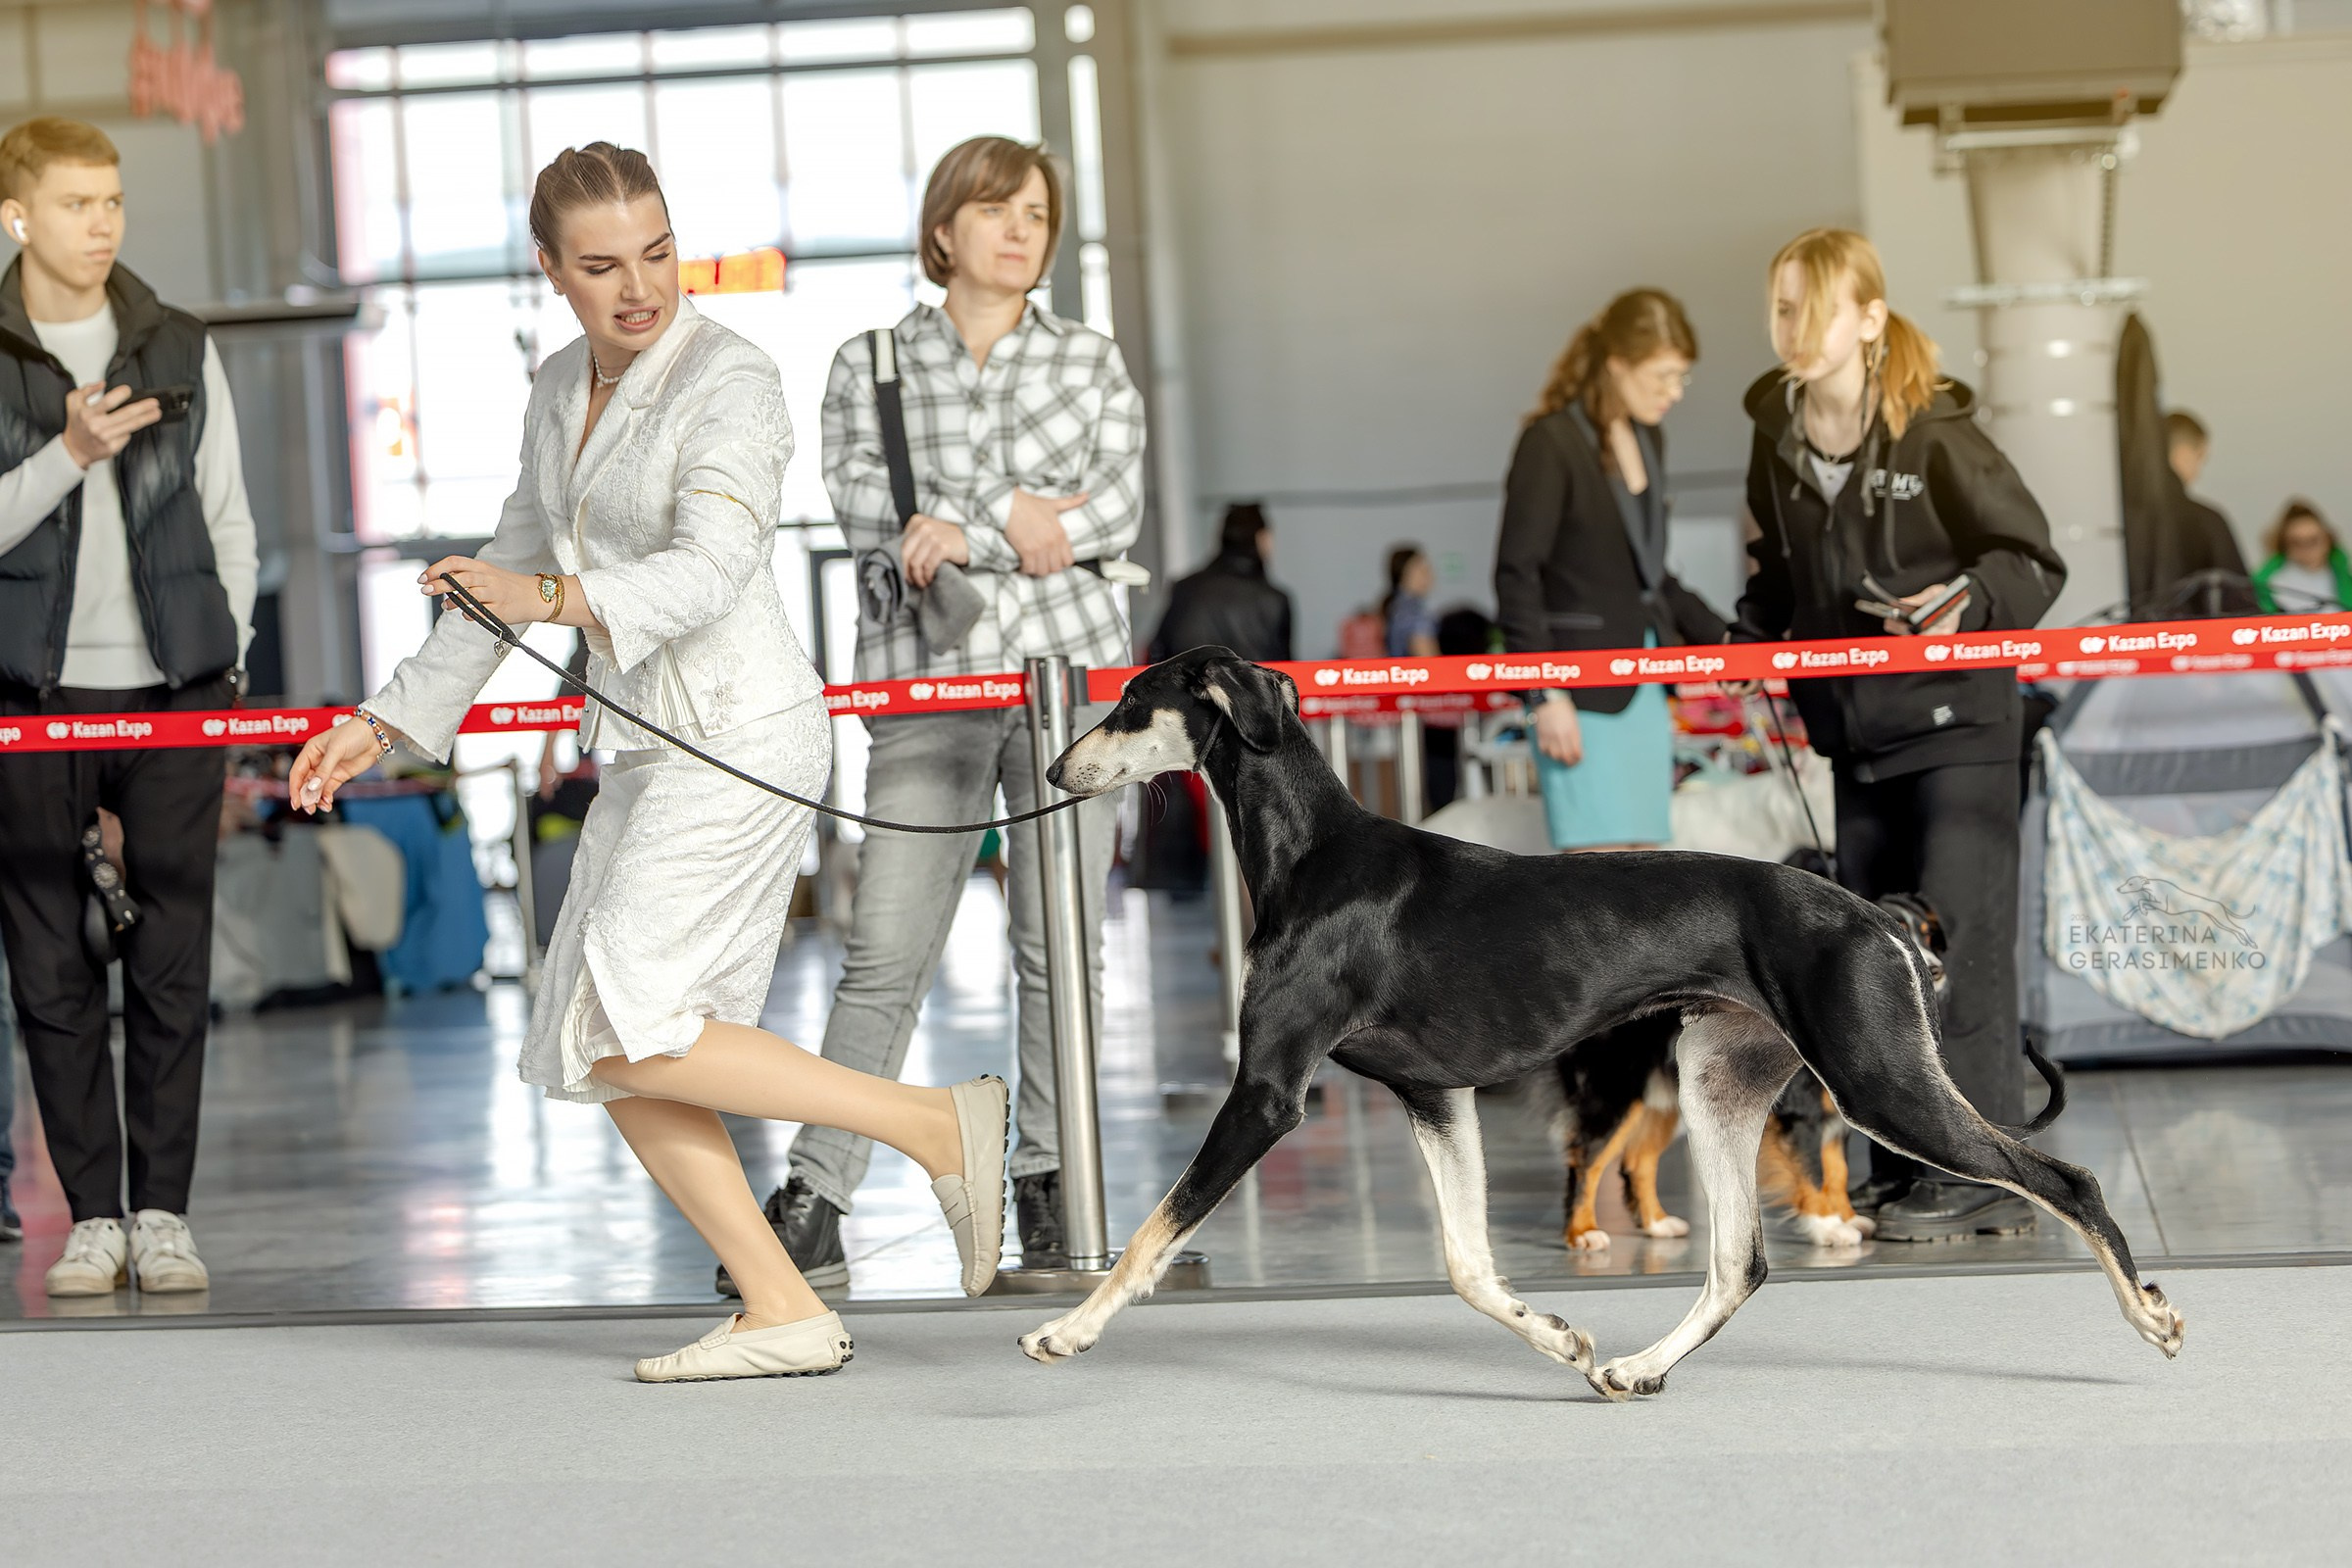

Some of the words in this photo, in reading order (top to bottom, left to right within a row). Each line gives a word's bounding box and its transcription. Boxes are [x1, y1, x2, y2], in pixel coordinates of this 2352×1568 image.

[2108, 635, 2156, 653] Kazan
[2157, 631, 2198, 652] Expo
[2261, 626, 2309, 644] Kazan
[2311, 622, 2351, 642] Expo
[1801, 650, 1848, 668] Kazan
[1849, 647, 1889, 668] Expo
[1953, 643, 2000, 661] Kazan
[2002, 640, 2042, 661] Expo
[1343, 667, 1389, 685] Kazan
[1390, 665, 1430, 686] Expo
[1494, 662, 1541, 680] Kazan
[1542, 662, 1581, 683] Expo
[1638, 657, 1685, 674] Kazan
[1686, 655, 1725, 675] Expo
[824, 694, 852, 710] zan
[852, 690, 890, 710] Expo
[936, 682, 981, 700] Kazan
[982, 680, 1021, 701] Expo
[228, 717, 271, 735] Kazan
[272, 714, 310, 736] Expo
[516, 706, 562, 724] Kazan
[72, 721, 116, 739] Kazan
[117, 719, 153, 740] Expo
